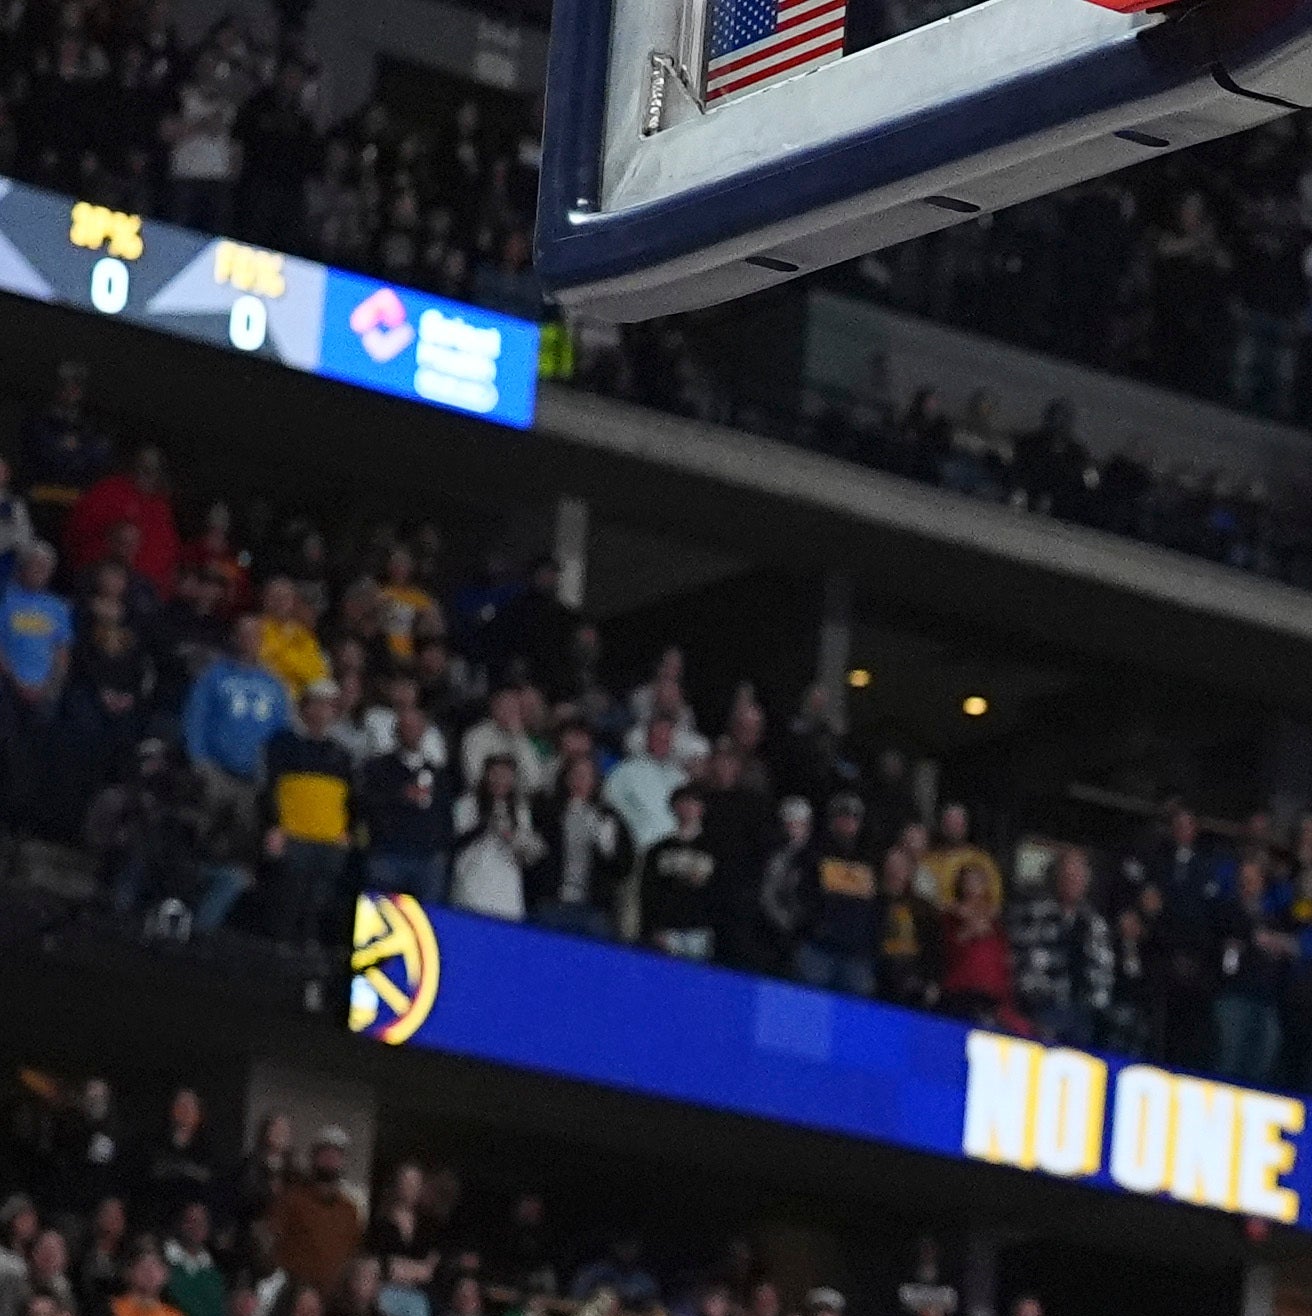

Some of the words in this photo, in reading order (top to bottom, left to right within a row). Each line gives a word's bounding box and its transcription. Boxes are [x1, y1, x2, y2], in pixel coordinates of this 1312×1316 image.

[91, 257, 130, 314] 0
[229, 295, 267, 351] 0
[963, 1029, 1108, 1179] NO
[1110, 1064, 1305, 1225] ONE
